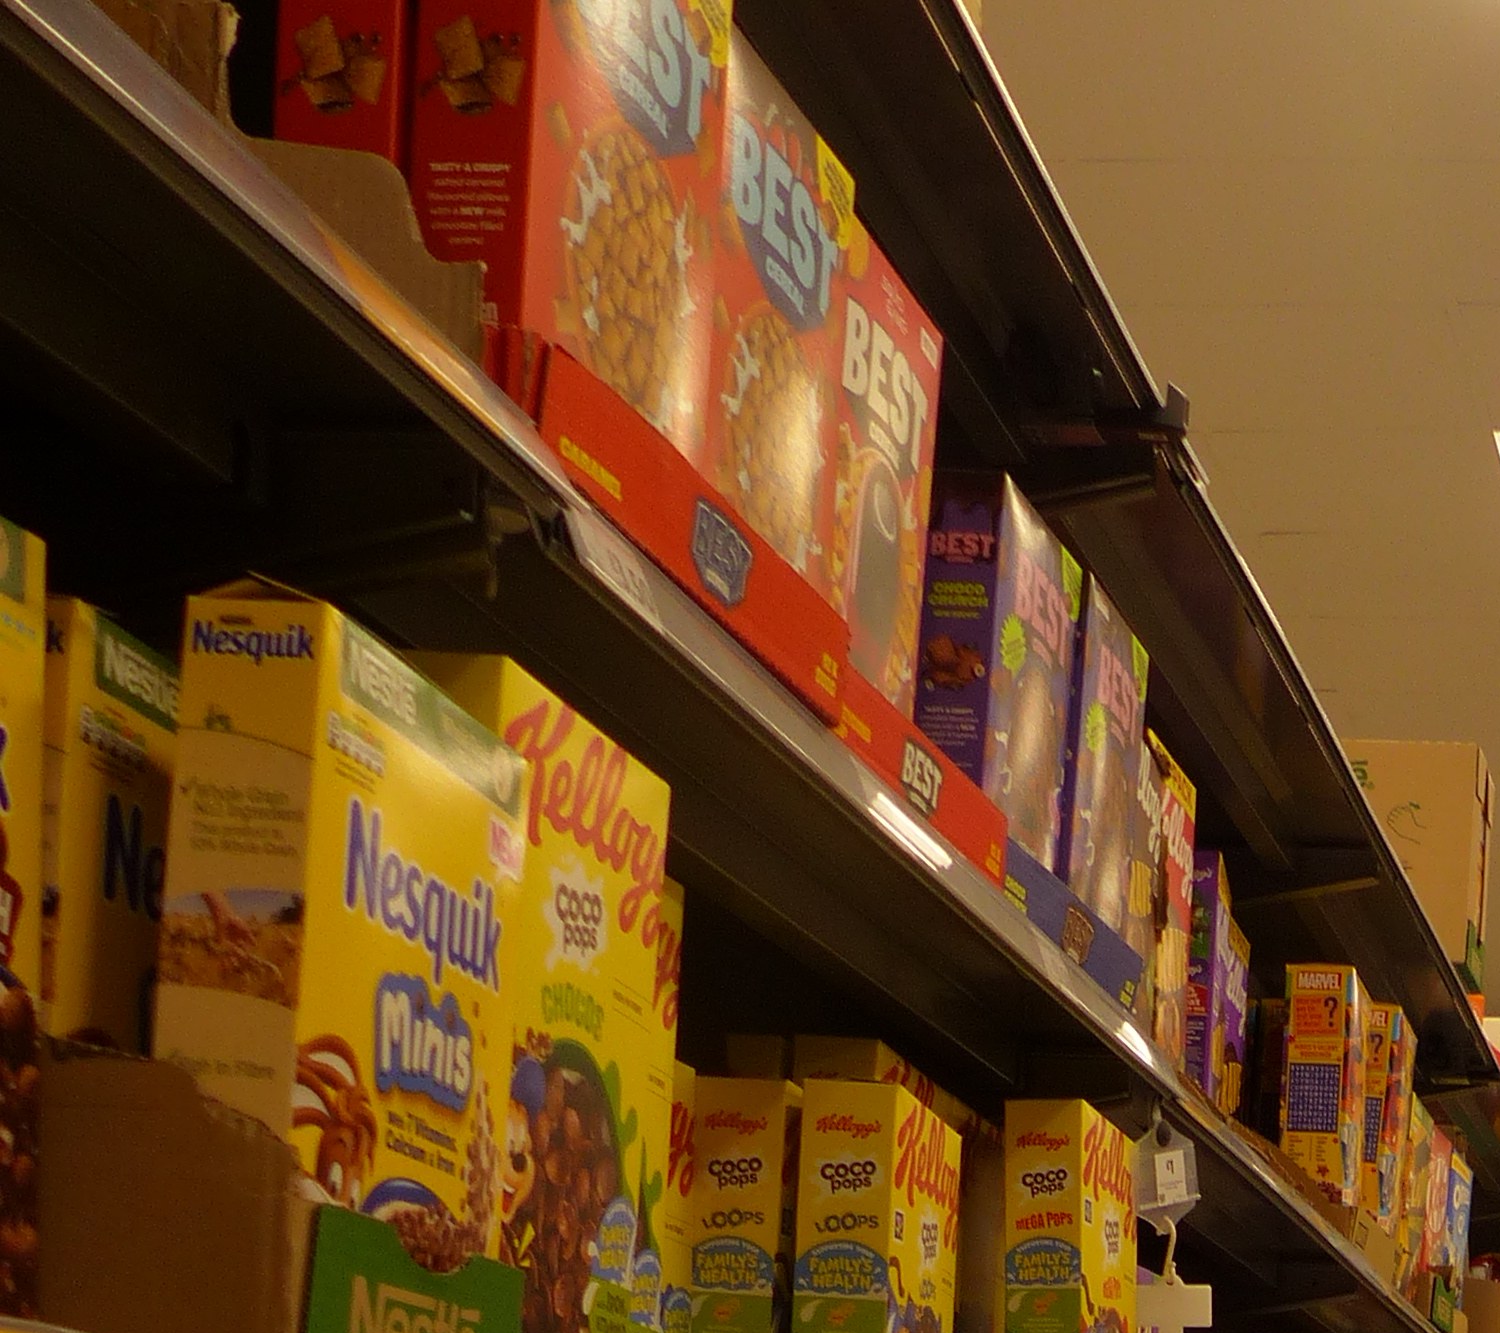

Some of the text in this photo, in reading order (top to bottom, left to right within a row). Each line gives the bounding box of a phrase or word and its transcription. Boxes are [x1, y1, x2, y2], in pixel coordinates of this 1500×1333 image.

[731, 113, 840, 318] BEST
[842, 296, 928, 474] BEST
[930, 531, 996, 561] BEST
[192, 620, 316, 666] Nesquik
[903, 741, 943, 808] BEST
[344, 796, 500, 994] Nesquik
[1298, 972, 1341, 991] MARVEL
[379, 990, 472, 1094] Minis
[718, 1172, 759, 1191] pops
[830, 1176, 872, 1194] pops
[1030, 1180, 1065, 1199] pops
[701, 1208, 765, 1231] LOOPS
[815, 1211, 880, 1233] LOOPS
[1014, 1210, 1074, 1231] MEGA POPS
[696, 1252, 759, 1269] FAMILY'S
[809, 1257, 874, 1274] FAMILY'S
[1014, 1251, 1071, 1267] FAMILY'S
[699, 1267, 757, 1286] HEALTH
[812, 1272, 873, 1289] HEALTH
[1018, 1265, 1071, 1281] HEALTH
